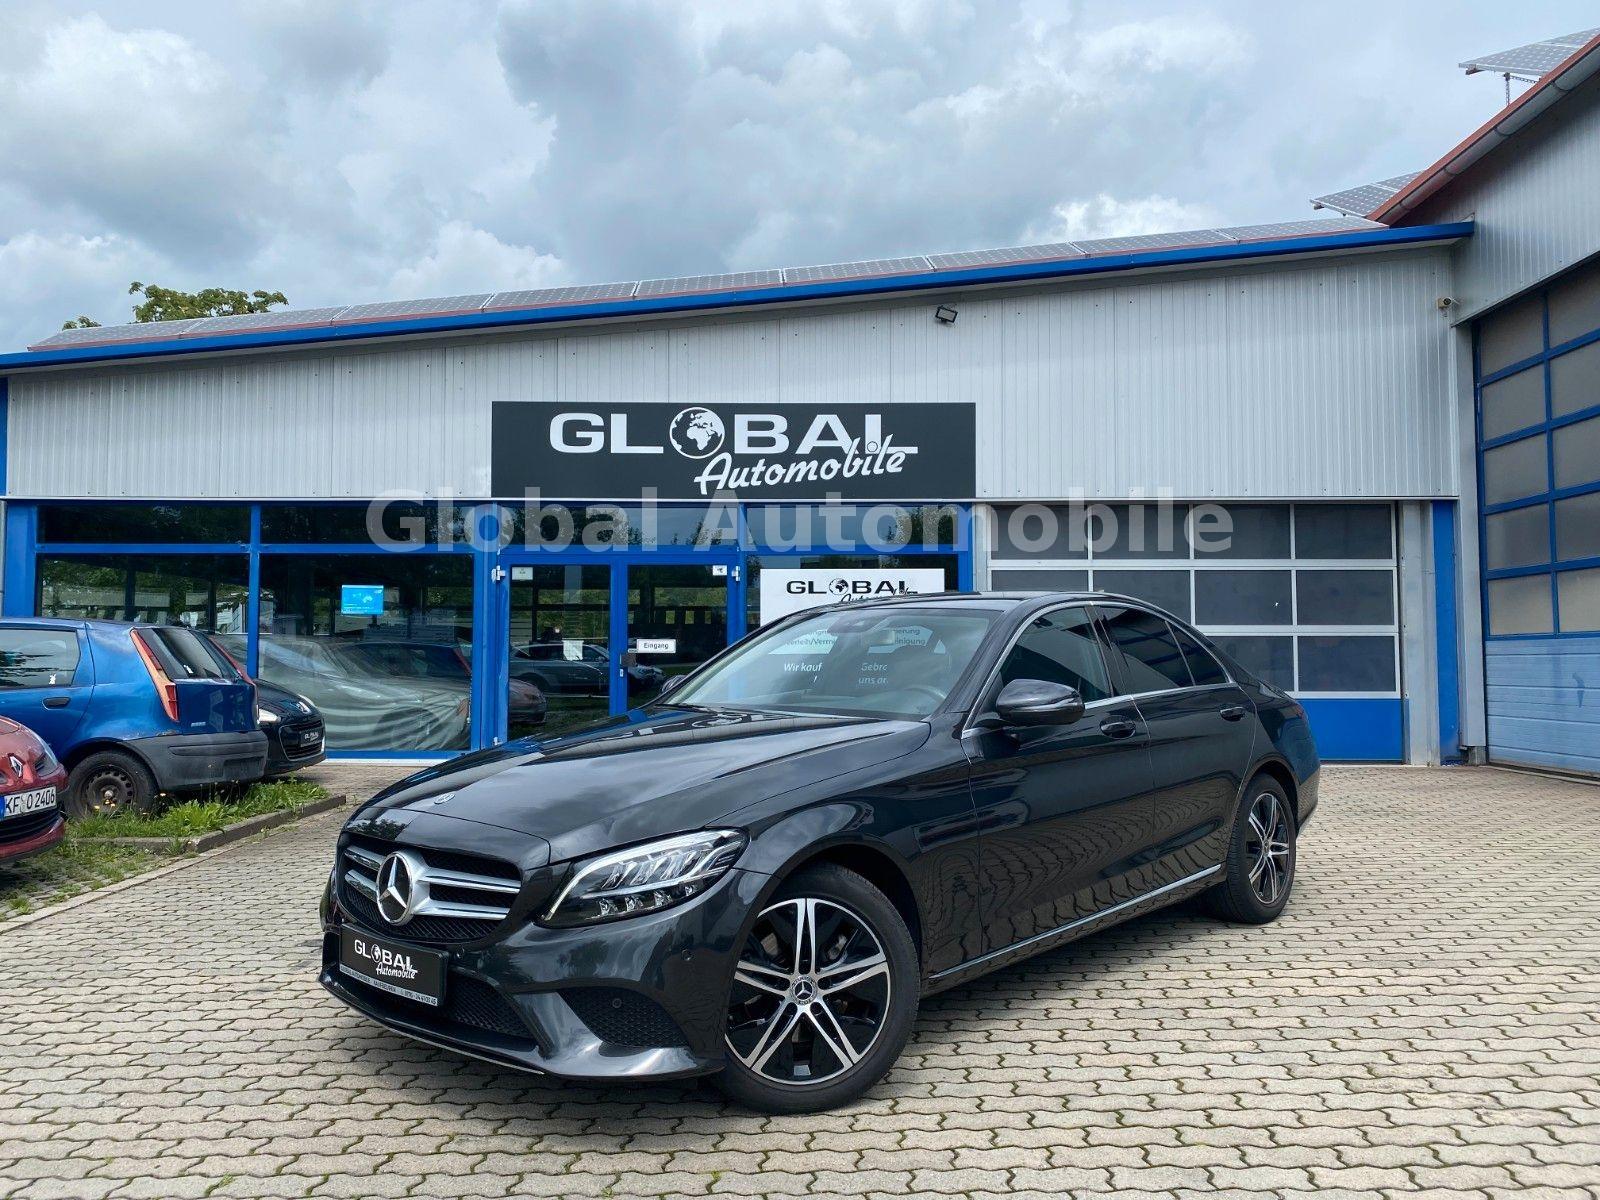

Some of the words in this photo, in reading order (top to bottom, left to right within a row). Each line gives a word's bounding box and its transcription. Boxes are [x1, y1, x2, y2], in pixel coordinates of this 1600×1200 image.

[549, 407, 918, 458] GLOBAL
[693, 433, 906, 495] Automobile
[786, 578, 918, 595] GLOBAL
[643, 641, 669, 650] Eingang
[784, 663, 799, 671] Wir
[6, 796, 20, 813] KF
[34, 789, 55, 808] 2406
[354, 939, 418, 974] GLOBAL
[376, 962, 416, 979] Automobile
